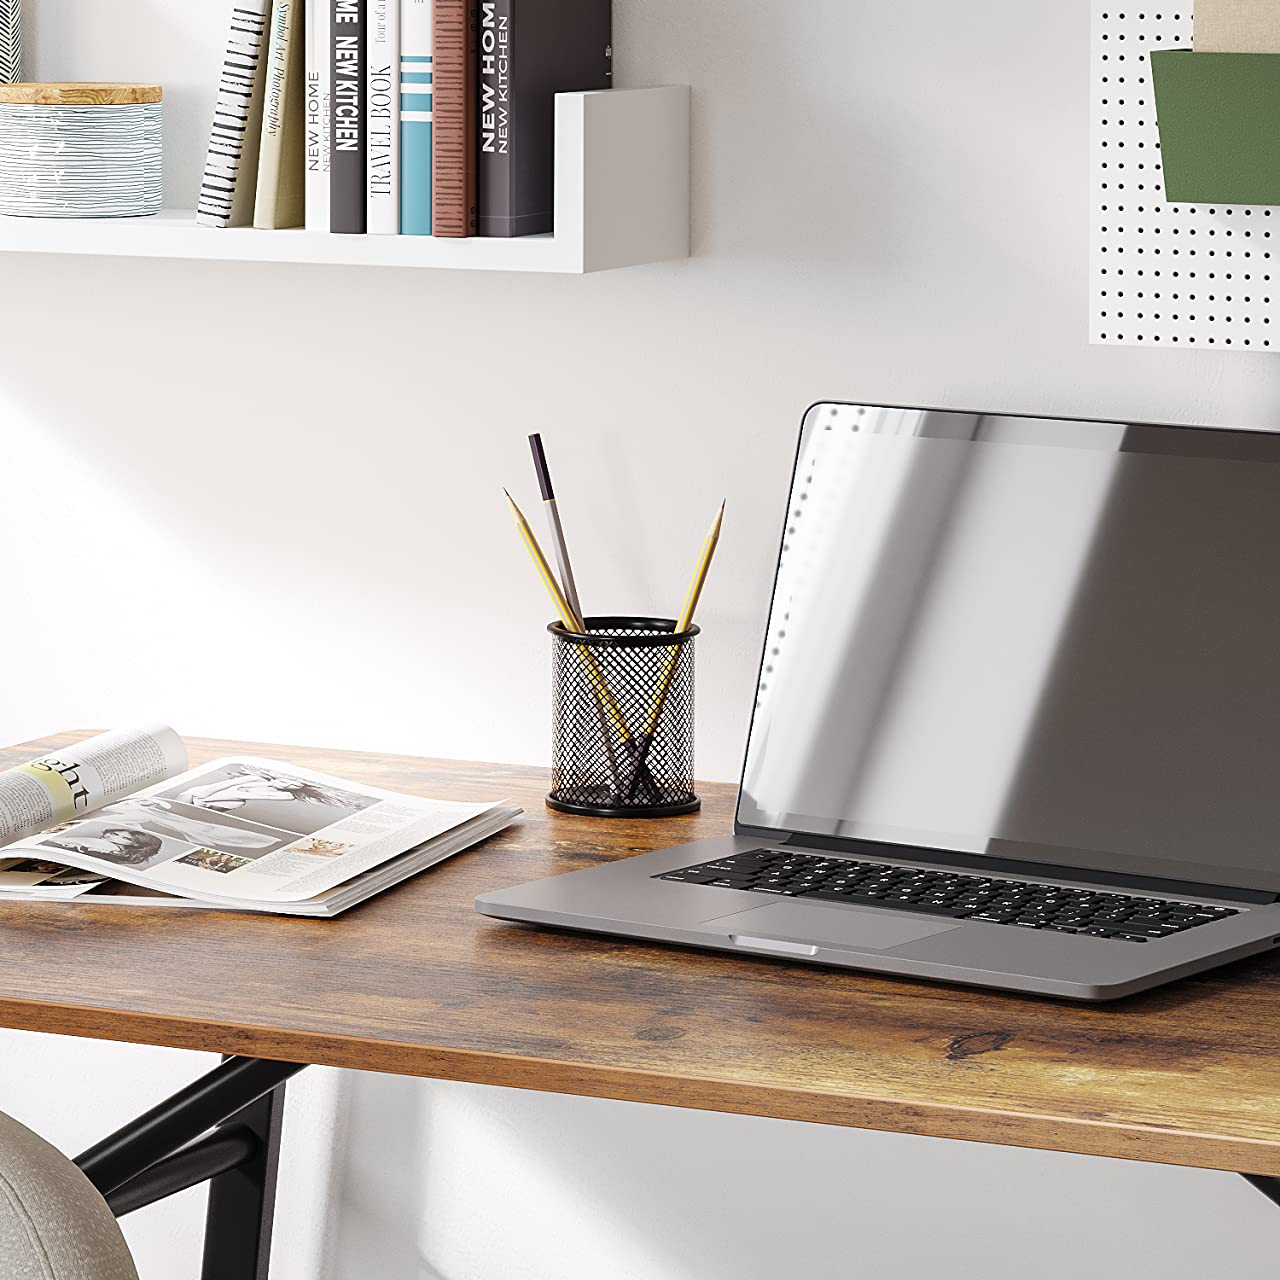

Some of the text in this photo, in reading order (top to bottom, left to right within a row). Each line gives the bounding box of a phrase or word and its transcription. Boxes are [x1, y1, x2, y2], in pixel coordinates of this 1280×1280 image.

[374, 10, 386, 21] of
[375, 22, 387, 44] Tour
[267, 1, 291, 137] Symbol Art Photography
[335, 36, 359, 77] NEW
[498, 16, 508, 154] NEW KITCHEN
[308, 71, 320, 172] NEW HOME
[322, 92, 331, 172] NEW KITCHEN
[335, 80, 359, 151] KITCHEN
[370, 65, 392, 198] TRAVEL BOOK
[482, 83, 495, 153] NEW
